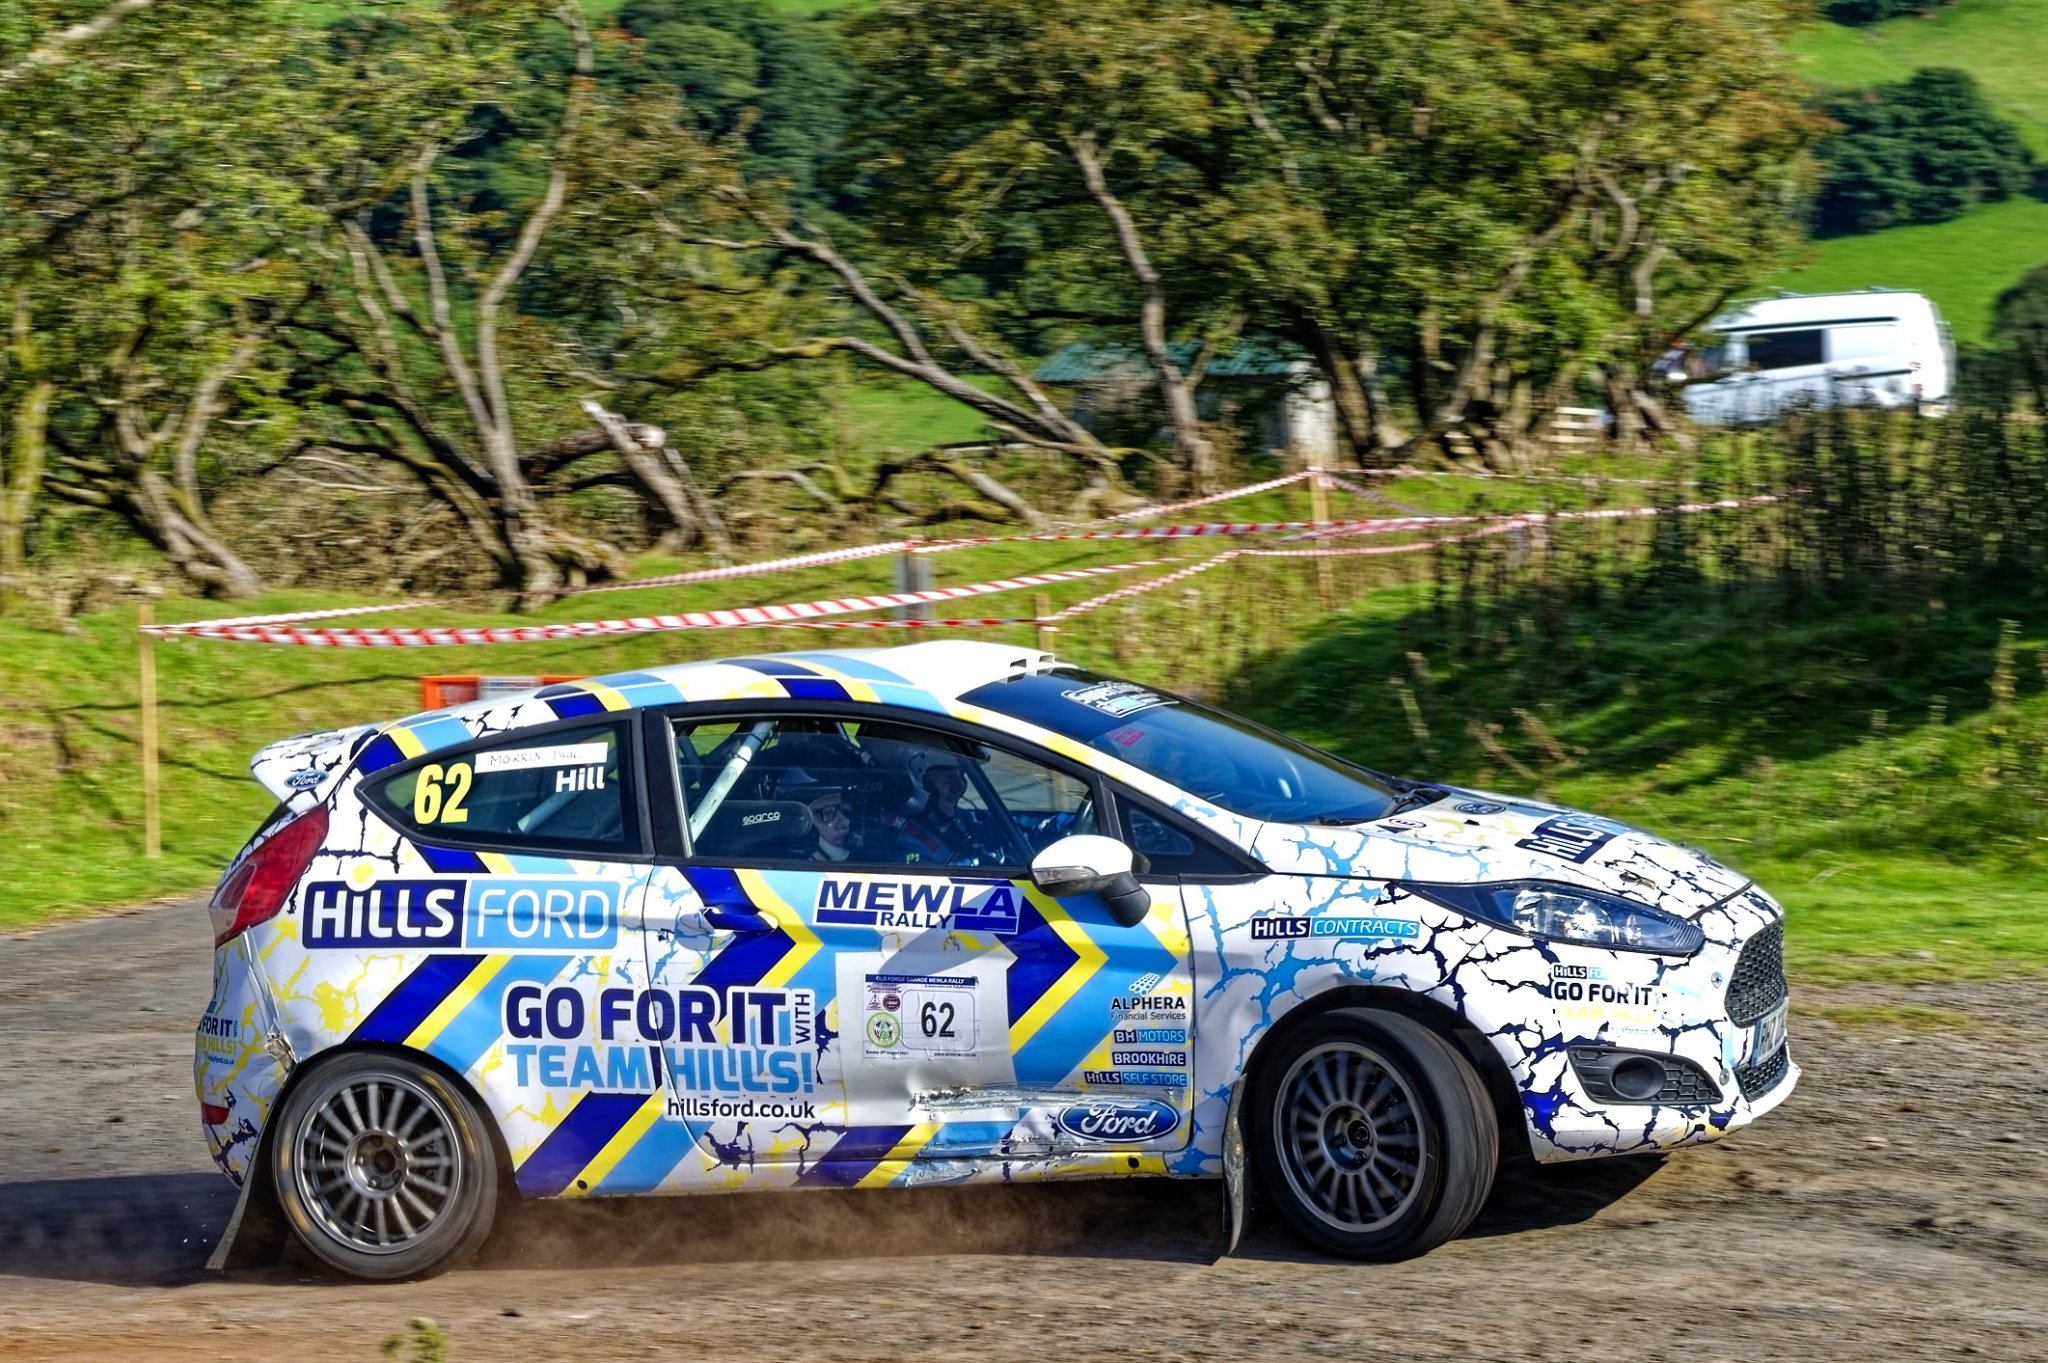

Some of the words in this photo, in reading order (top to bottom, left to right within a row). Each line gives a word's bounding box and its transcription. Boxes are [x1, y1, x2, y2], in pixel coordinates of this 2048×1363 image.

[292, 772, 320, 786] Ford
[555, 766, 605, 793] Hill
[414, 762, 472, 824] 62
[742, 811, 781, 826] sparco
[818, 880, 1016, 917] MEWLA
[477, 889, 609, 938] FORD
[880, 912, 953, 929] RALLY
[1314, 919, 1419, 936] CONTRACTS
[1111, 997, 1185, 1010] ALPHERA
[1554, 981, 1583, 1001] GO
[1589, 983, 1629, 1004] FOR
[1635, 986, 1652, 1005] IT
[202, 1016, 218, 1035] FOR
[220, 1019, 232, 1037] IT
[506, 986, 585, 1040] GO
[600, 988, 717, 1043] FOR
[732, 992, 786, 1045] IT
[794, 993, 811, 1045] WITH
[921, 1001, 955, 1038] 62
[1111, 1012, 1147, 1020] Financial
[1151, 1012, 1186, 1020] Services
[1116, 1031, 1136, 1042] BH
[1139, 1030, 1184, 1042] MOTORS
[507, 1045, 651, 1089] TEAM
[667, 1048, 814, 1093] HILLS!
[1123, 1073, 1149, 1084] SELF
[1152, 1074, 1186, 1085] STORE
[667, 1098, 815, 1120] hillsford.co.uk
[1080, 1101, 1158, 1134] Ford
